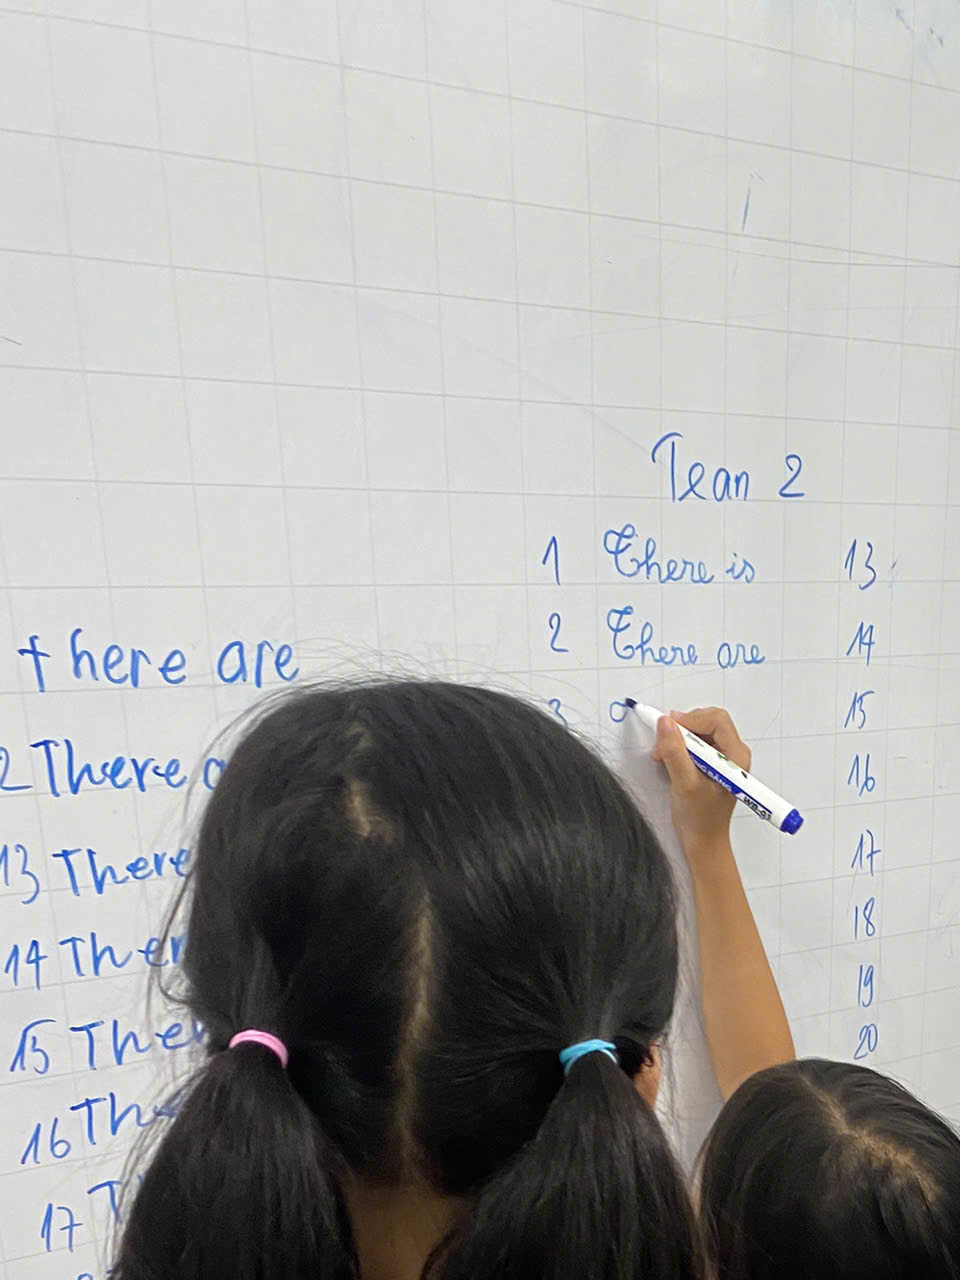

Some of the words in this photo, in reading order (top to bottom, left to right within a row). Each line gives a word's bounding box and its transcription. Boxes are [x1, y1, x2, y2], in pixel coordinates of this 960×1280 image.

[778, 453, 805, 498] 2
[541, 535, 561, 585] 1
[603, 523, 715, 584] There
[725, 552, 756, 584] is
[843, 538, 877, 591] 13
[548, 611, 569, 654] 2
[606, 604, 699, 666] There
[717, 642, 766, 669] are
[846, 620, 876, 666] 14
[216, 639, 300, 689] are
[843, 689, 874, 729] 15
[0, 745, 33, 791] 2
[29, 738, 188, 798] There
[847, 752, 876, 797] 16
[0, 844, 40, 905] 13
[850, 828, 882, 878] 17
[854, 896, 877, 942] 18
[4, 939, 49, 991] 14
[58, 932, 188, 977] Ther
[857, 964, 876, 1009] 19
[9, 1018, 57, 1075] 15
[853, 1023, 879, 1060] 20
[20, 1116, 72, 1166] 16
[41, 1202, 83, 1253] 17
